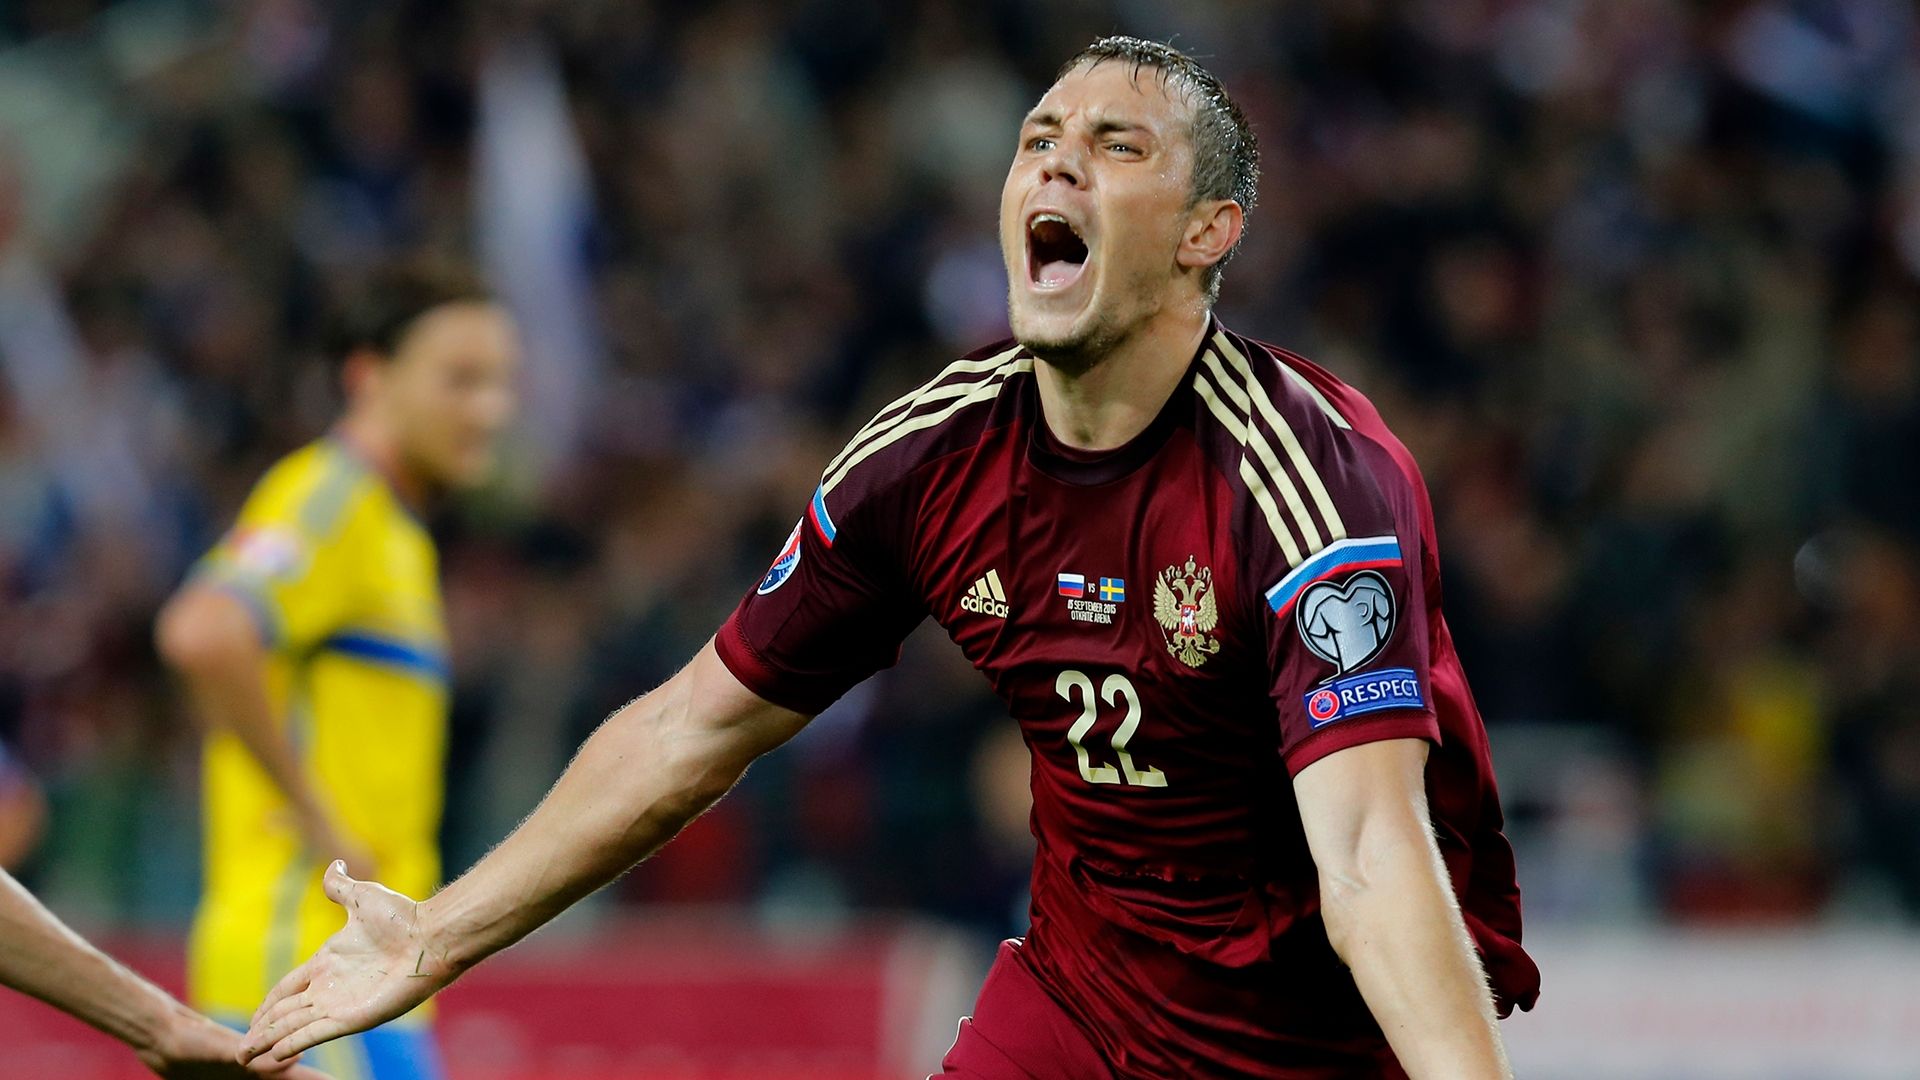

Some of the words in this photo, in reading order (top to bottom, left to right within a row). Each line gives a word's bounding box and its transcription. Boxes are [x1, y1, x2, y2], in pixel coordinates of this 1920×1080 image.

[1087, 582, 1096, 593] VS
[1074, 600, 1103, 612] SEPTEMBER
[1103, 603, 1117, 614] 2015
[1094, 612, 1112, 624] ARENA
[1341, 679, 1418, 706] RESPECT
[1055, 669, 1168, 787] 22
